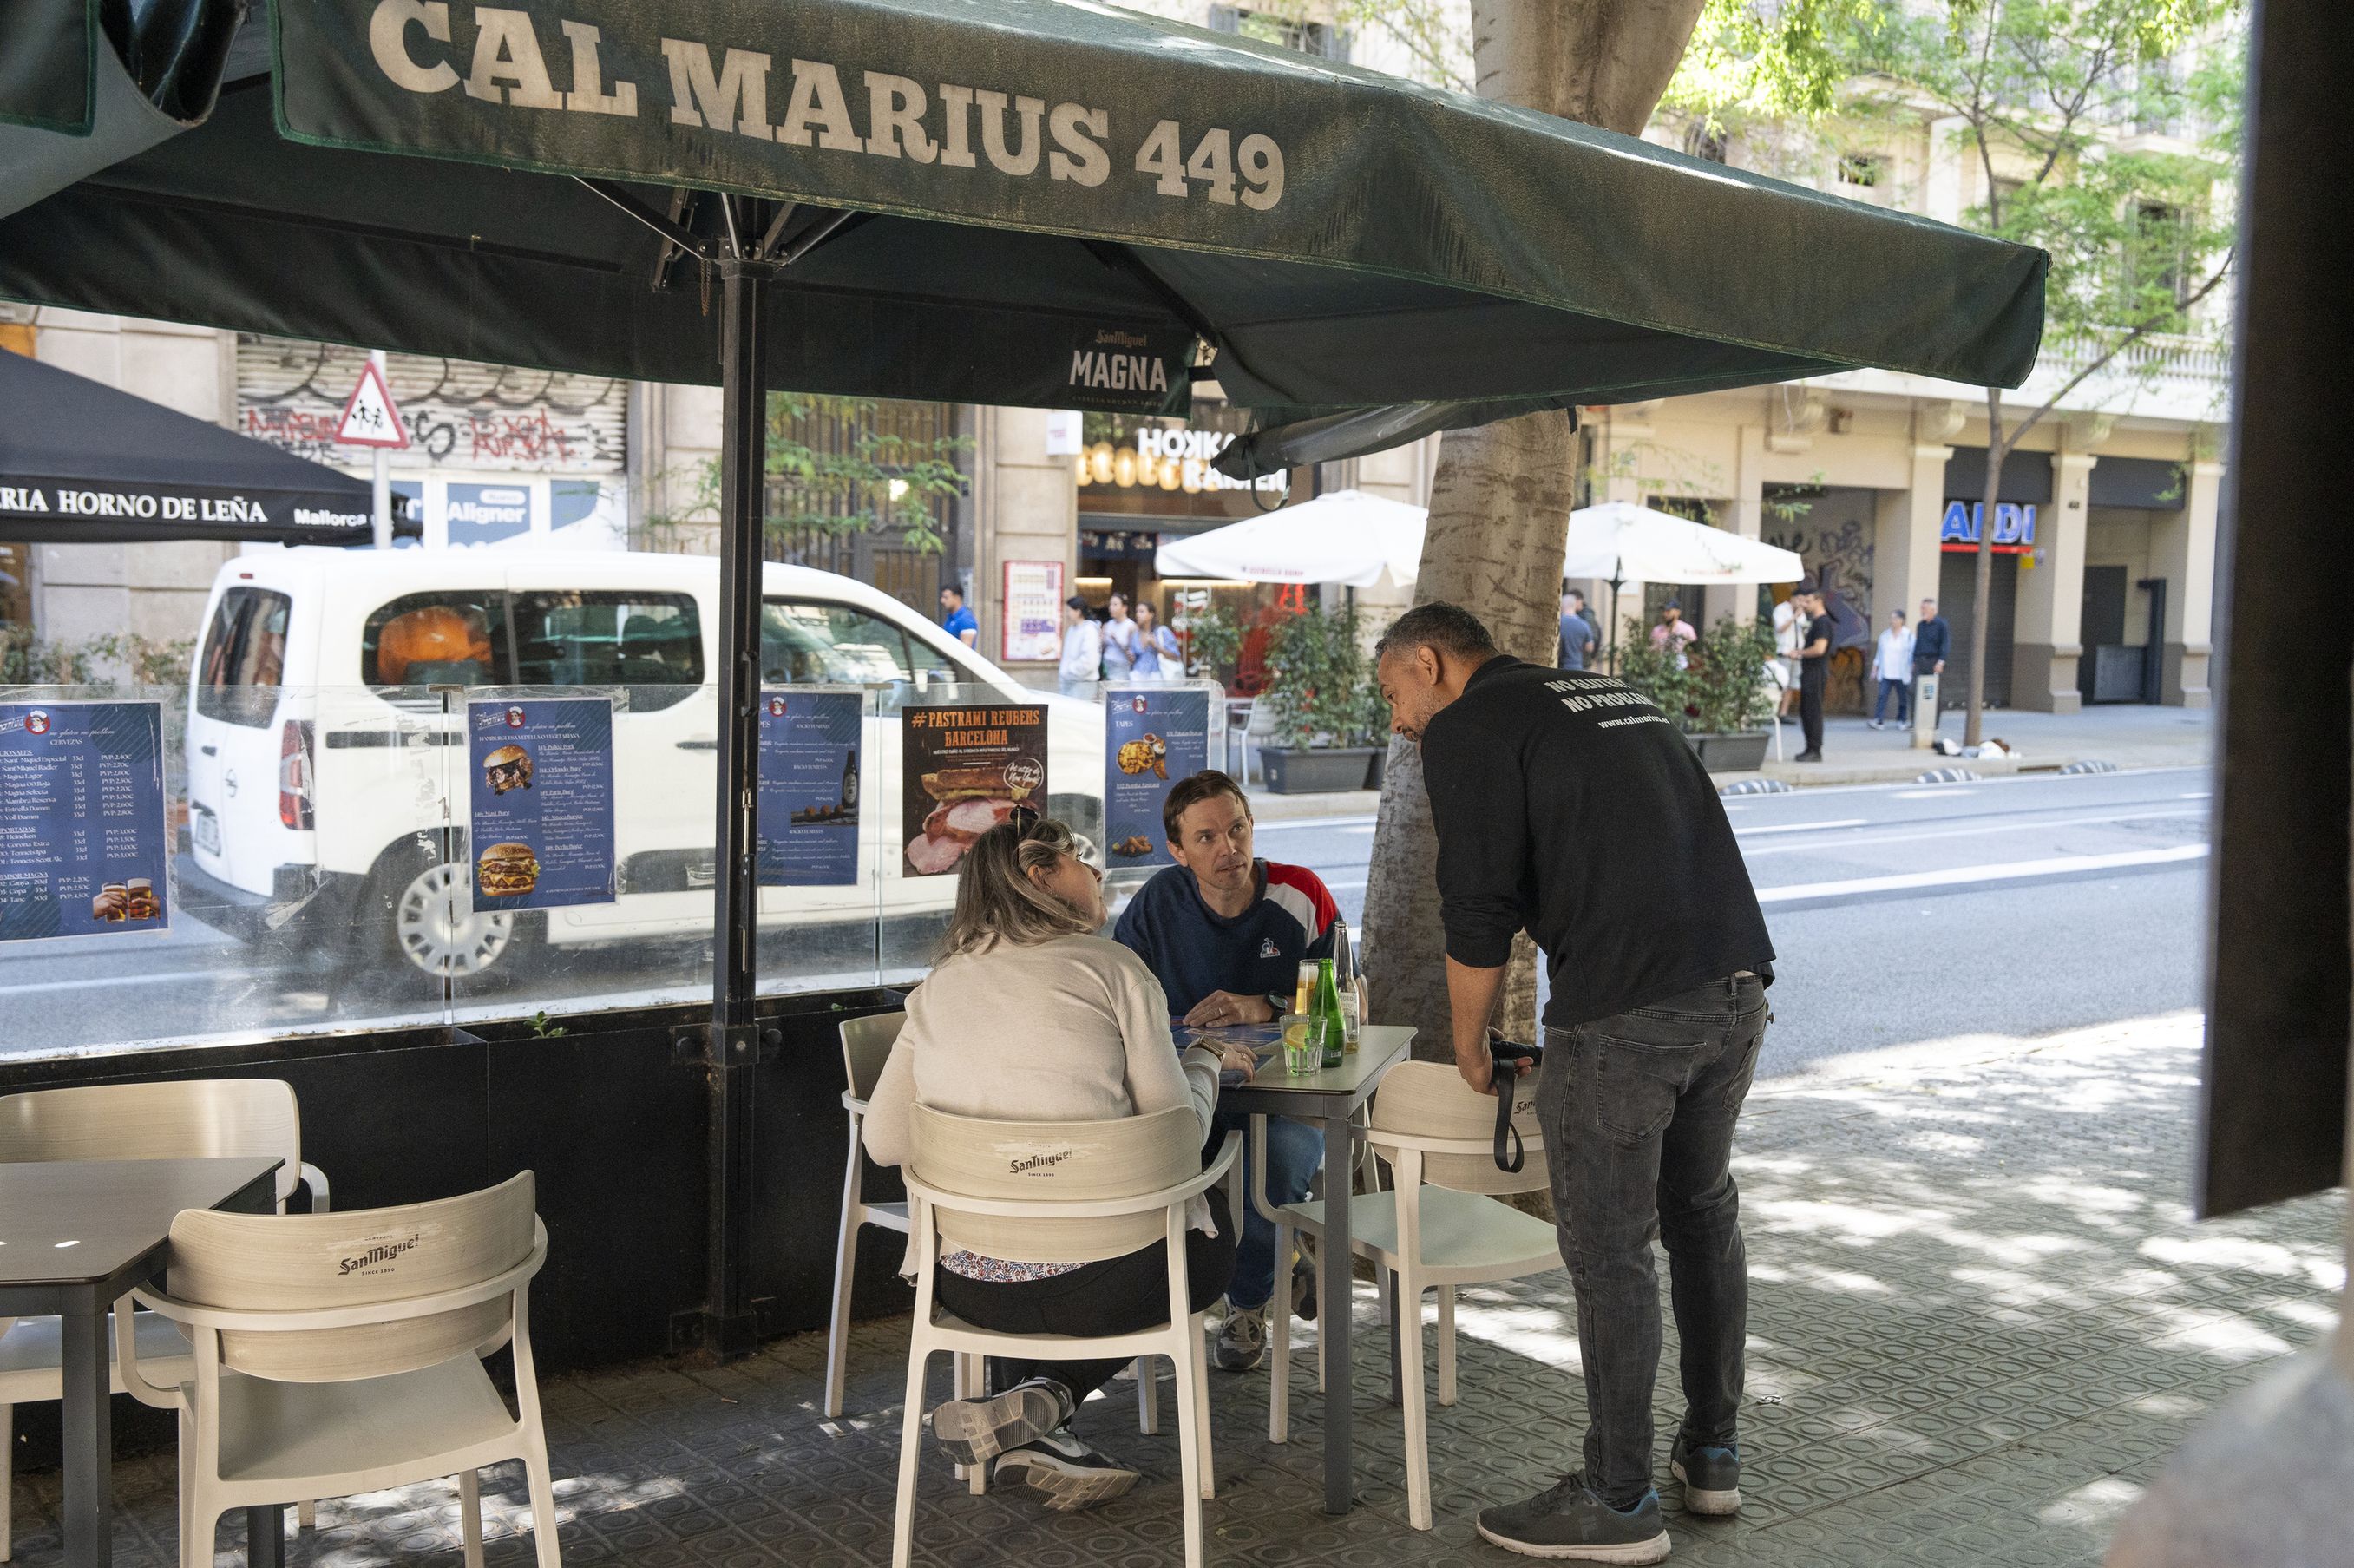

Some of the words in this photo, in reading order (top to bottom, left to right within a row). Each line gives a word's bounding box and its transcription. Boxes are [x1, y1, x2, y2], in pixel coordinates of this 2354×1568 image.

[370, 0, 638, 117] CAL
[661, 37, 1111, 187] MARIUS
[1136, 119, 1284, 211] 449
[1069, 350, 1167, 392] MAGNA
[56, 489, 158, 520] HORNO
[161, 496, 197, 521] DE
[200, 495, 268, 522] LEÑA
[293, 508, 367, 528] Mallorca
[1544, 679, 1575, 692] NO
[1561, 695, 1593, 712] NO
[928, 710, 987, 727] PASTRAMI
[991, 710, 1040, 726] REUBENS
[944, 729, 1008, 747] BARCELONA
[338, 1233, 419, 1276] SanMiguel
